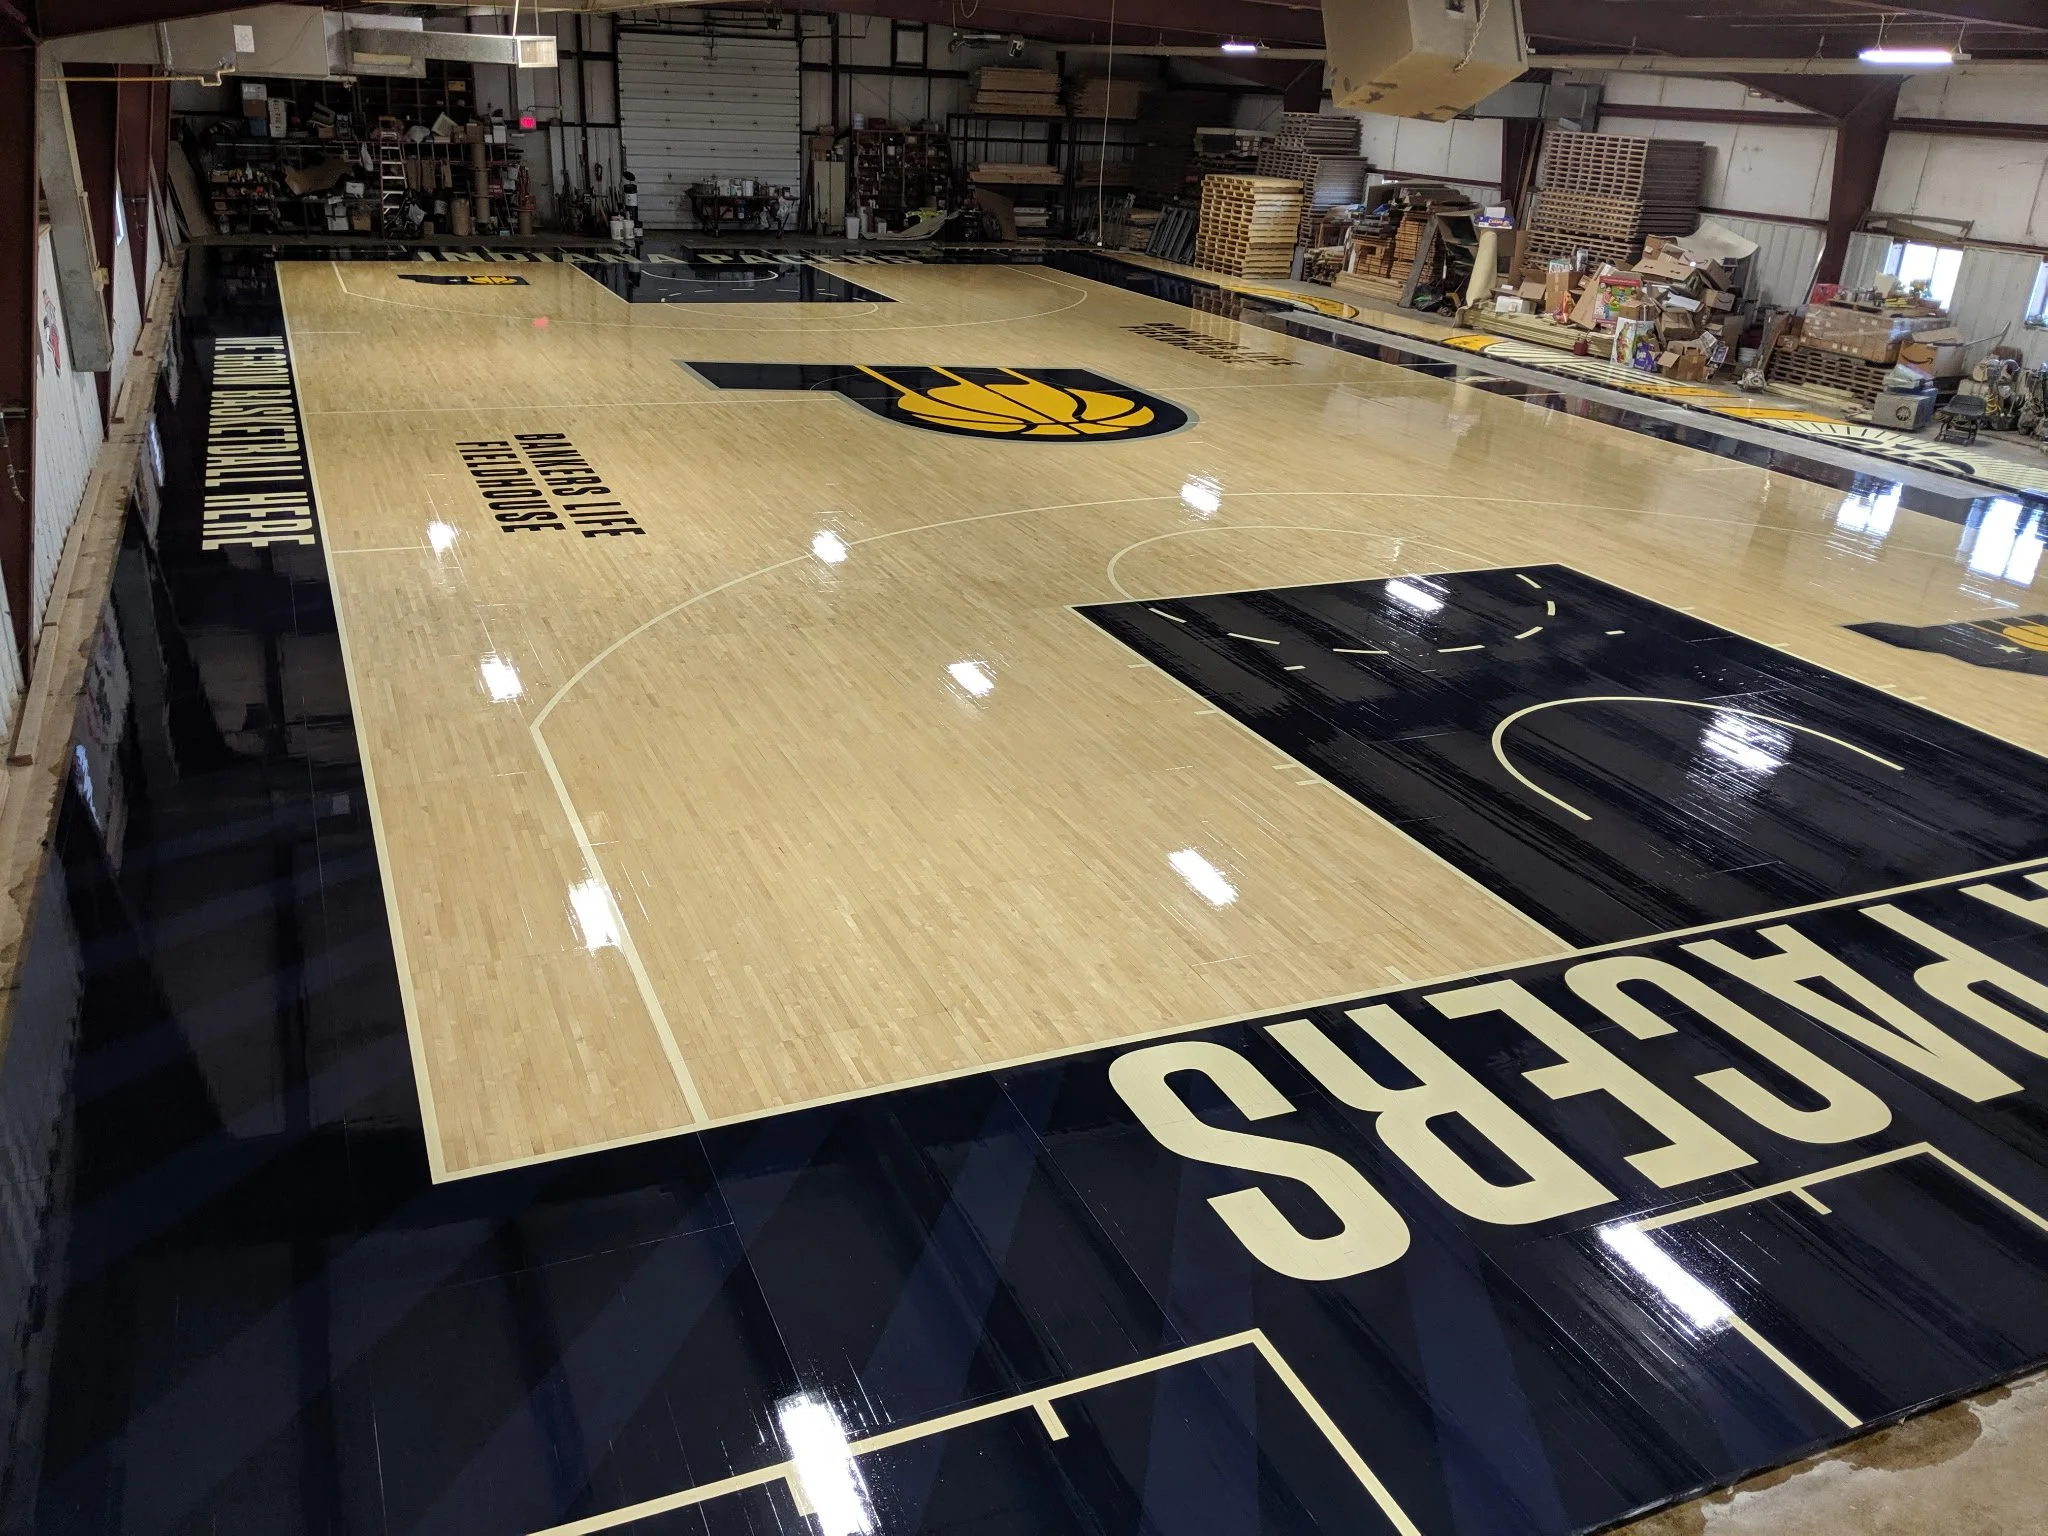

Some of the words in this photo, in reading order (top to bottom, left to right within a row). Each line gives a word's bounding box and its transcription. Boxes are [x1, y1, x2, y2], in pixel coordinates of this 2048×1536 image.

[417, 252, 689, 264] INDIANA
[697, 253, 923, 265] PACERS
[212, 353, 290, 384] GROW
[214, 336, 284, 350] WE
[204, 389, 304, 487] BASKETBALL
[202, 491, 315, 550] HERE
[455, 441, 566, 533] FIELDHOUSE
[513, 433, 611, 496] BANKERS
[562, 501, 647, 538] LIFE
[1108, 903, 2048, 1282] PACERS
